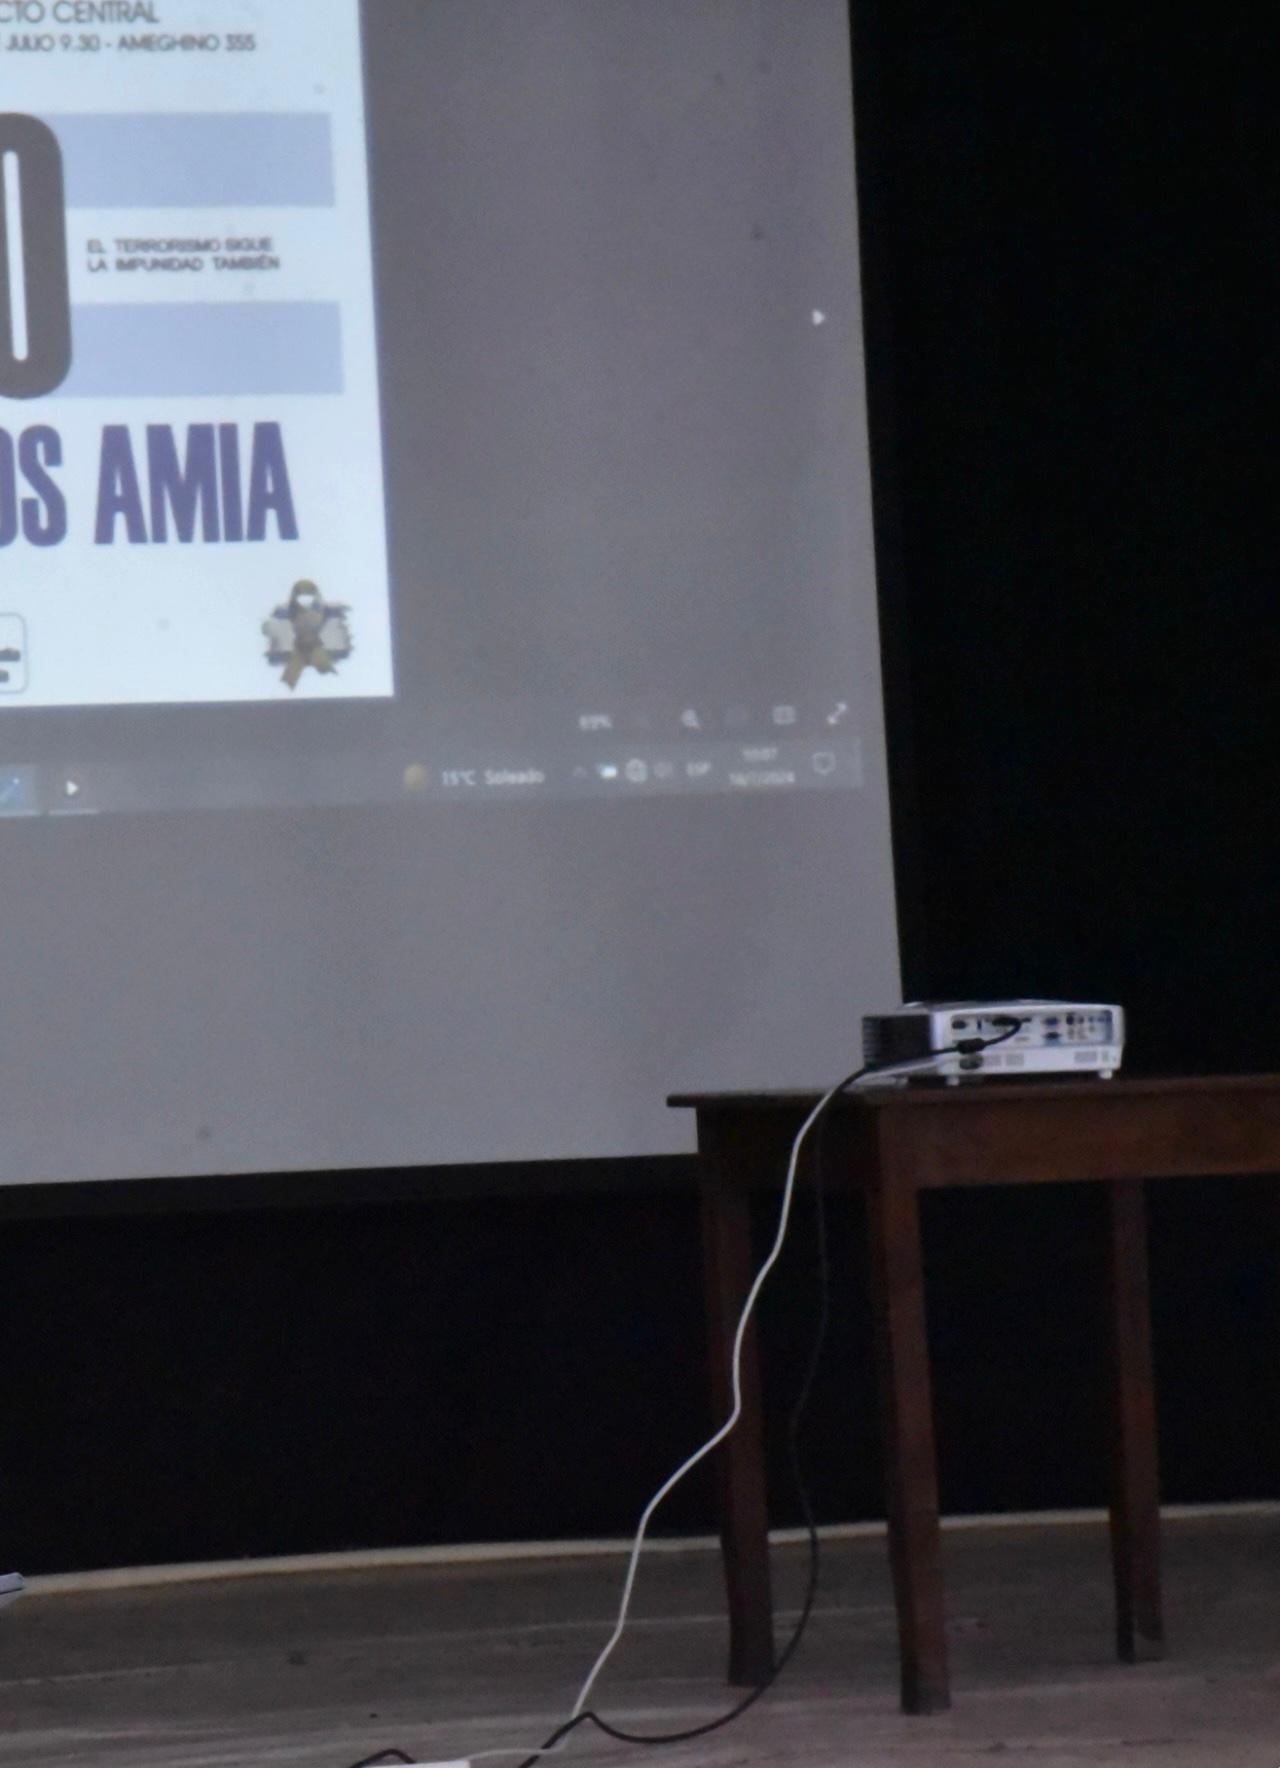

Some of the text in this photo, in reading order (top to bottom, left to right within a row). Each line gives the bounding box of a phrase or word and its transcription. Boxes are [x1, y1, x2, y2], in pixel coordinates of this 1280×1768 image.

[52, 0, 160, 23] CENTRAL
[6, 33, 55, 51] JULIO
[60, 33, 100, 51] 9.30
[119, 33, 220, 51] AMEGHINO
[87, 239, 105, 252] EL
[115, 238, 220, 252] TERRORISMO
[87, 258, 107, 272] LA
[116, 257, 204, 271] IMPUNIDAD
[94, 421, 300, 544] AMIA
